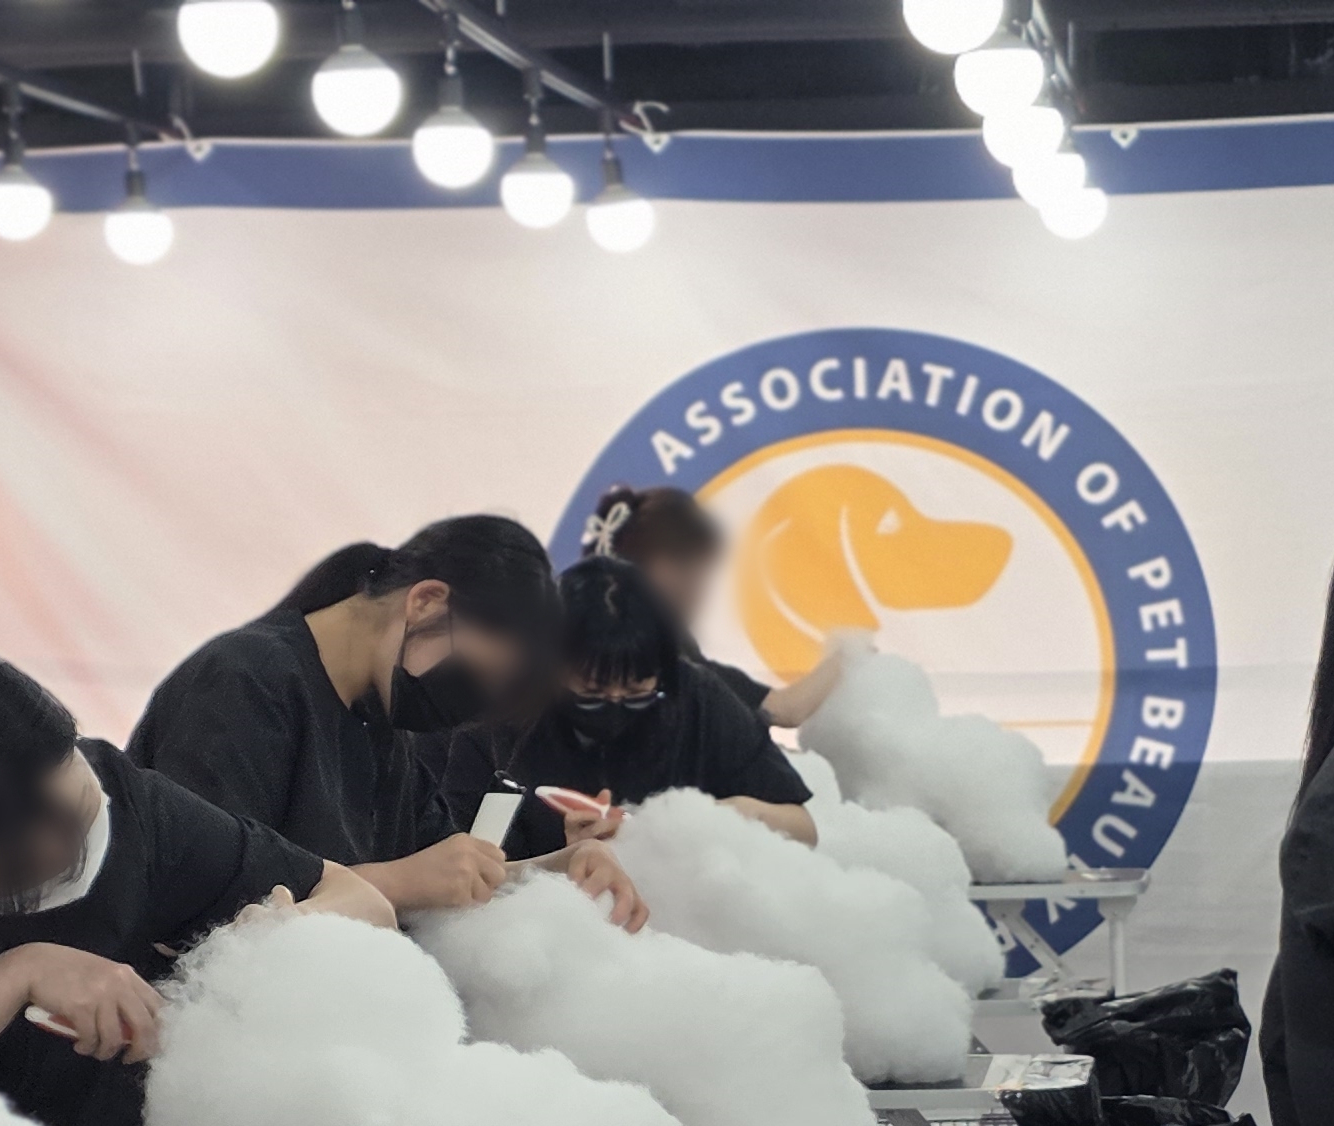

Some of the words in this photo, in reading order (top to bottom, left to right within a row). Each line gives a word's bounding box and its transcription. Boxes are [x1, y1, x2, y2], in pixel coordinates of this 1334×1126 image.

[651, 357, 1070, 475] ASSOCIATION
[1076, 462, 1148, 533] OF
[1127, 556, 1188, 669] PET
